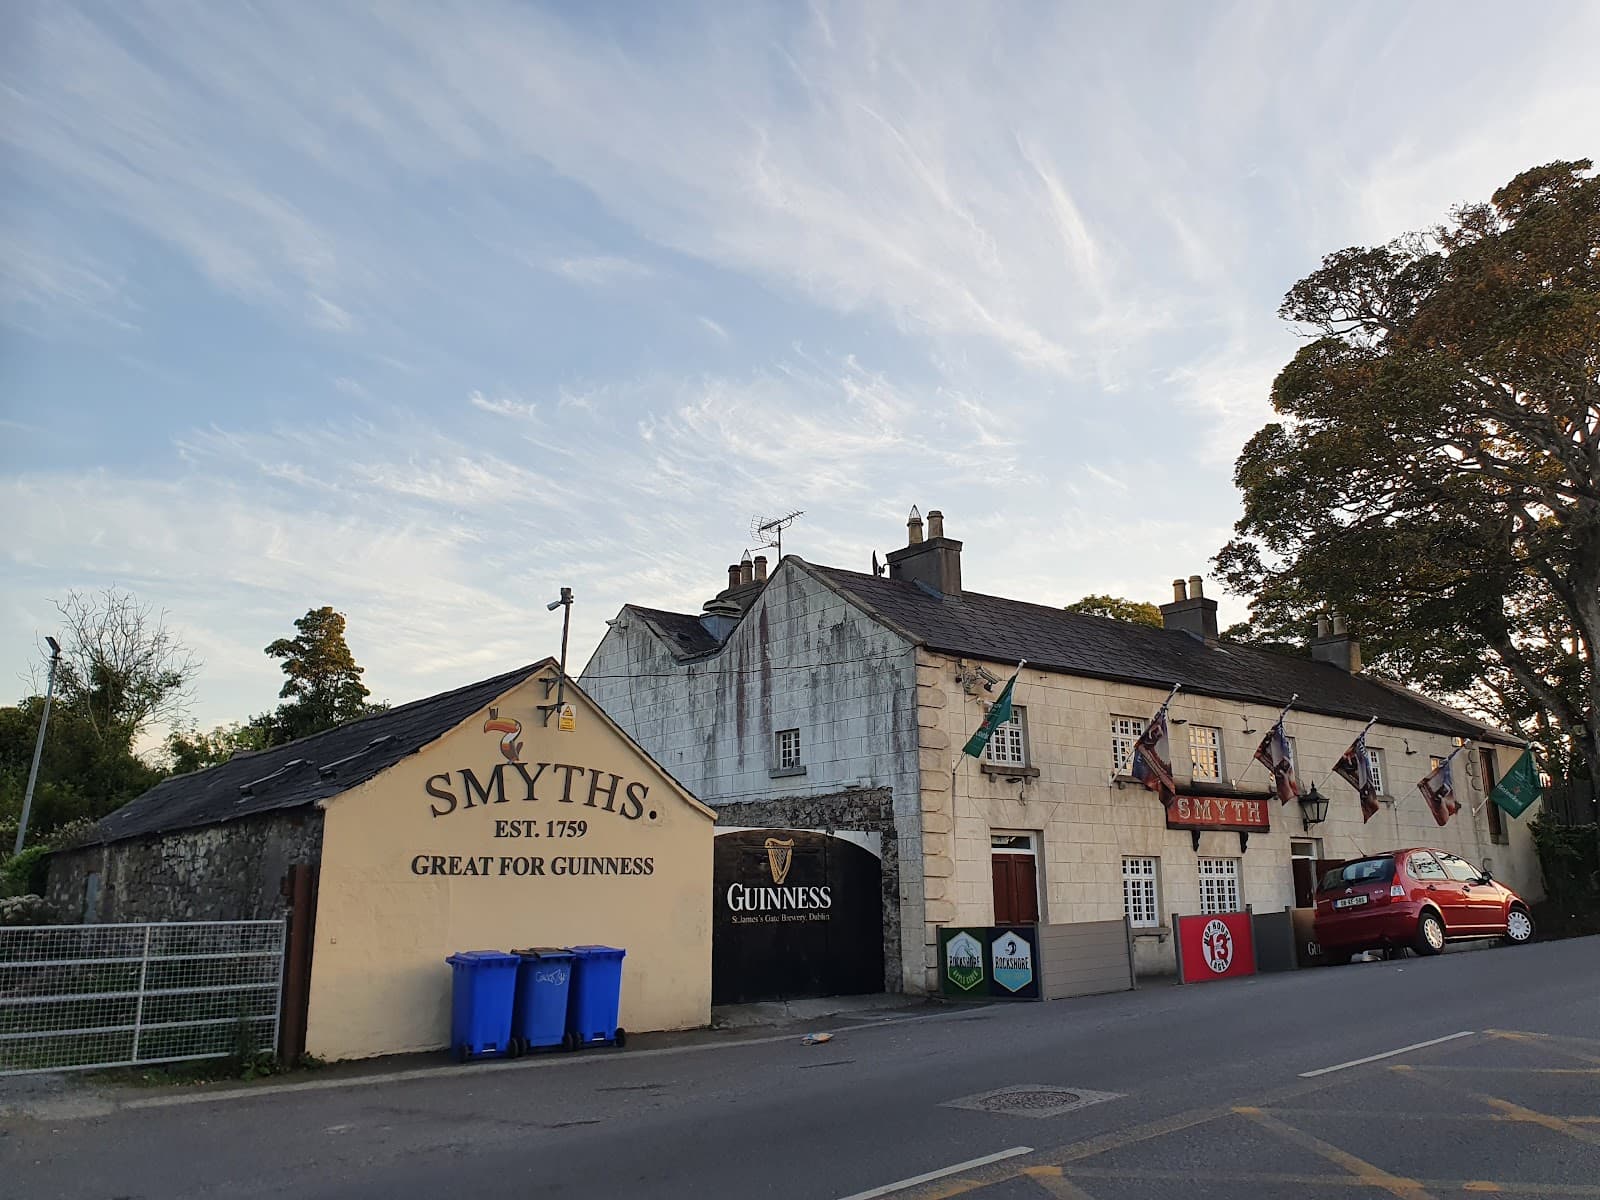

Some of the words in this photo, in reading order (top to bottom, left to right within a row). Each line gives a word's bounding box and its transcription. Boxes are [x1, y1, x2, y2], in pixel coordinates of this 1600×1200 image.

[1177, 797, 1261, 823] SMYTH
[494, 820, 540, 838] EST.
[547, 820, 588, 838] 1759
[411, 855, 494, 876] GREAT
[498, 856, 546, 876] FOR
[551, 857, 655, 876] GUINNESS
[727, 882, 832, 912] GUINNESS
[808, 912, 830, 921] Dublin
[1208, 933, 1229, 960] 13
[995, 956, 1029, 970] ROCKSHORE
